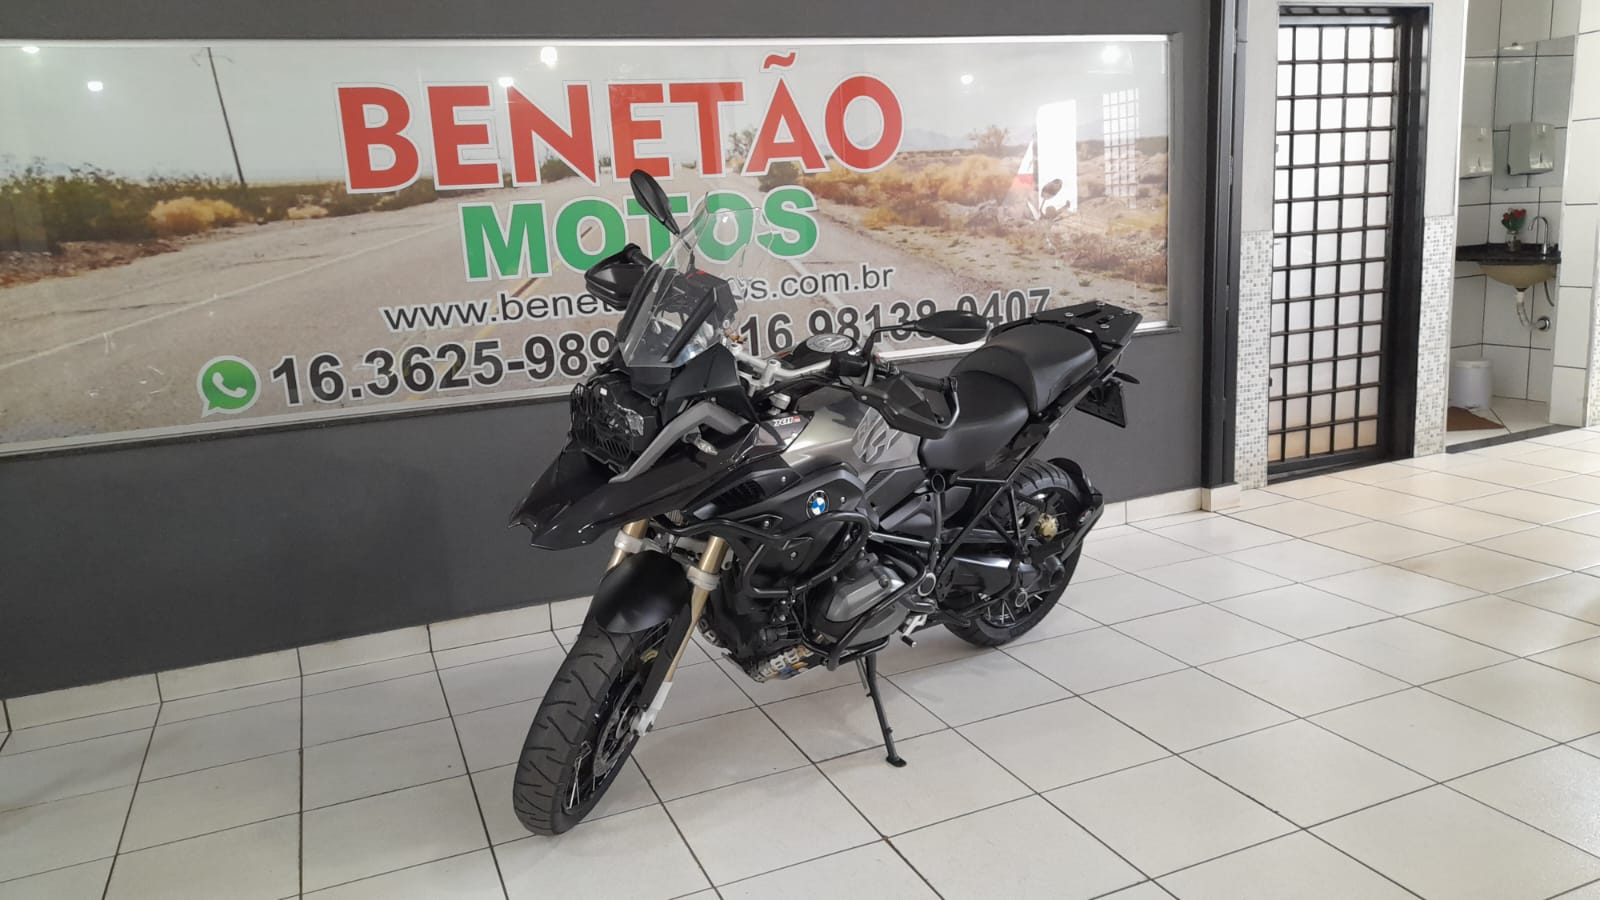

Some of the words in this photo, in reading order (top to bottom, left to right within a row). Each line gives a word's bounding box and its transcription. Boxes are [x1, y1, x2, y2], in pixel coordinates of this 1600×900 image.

[338, 53, 902, 190] BENETÃO
[462, 190, 817, 278] MOTOS
[272, 333, 616, 405] 16.3625-989
